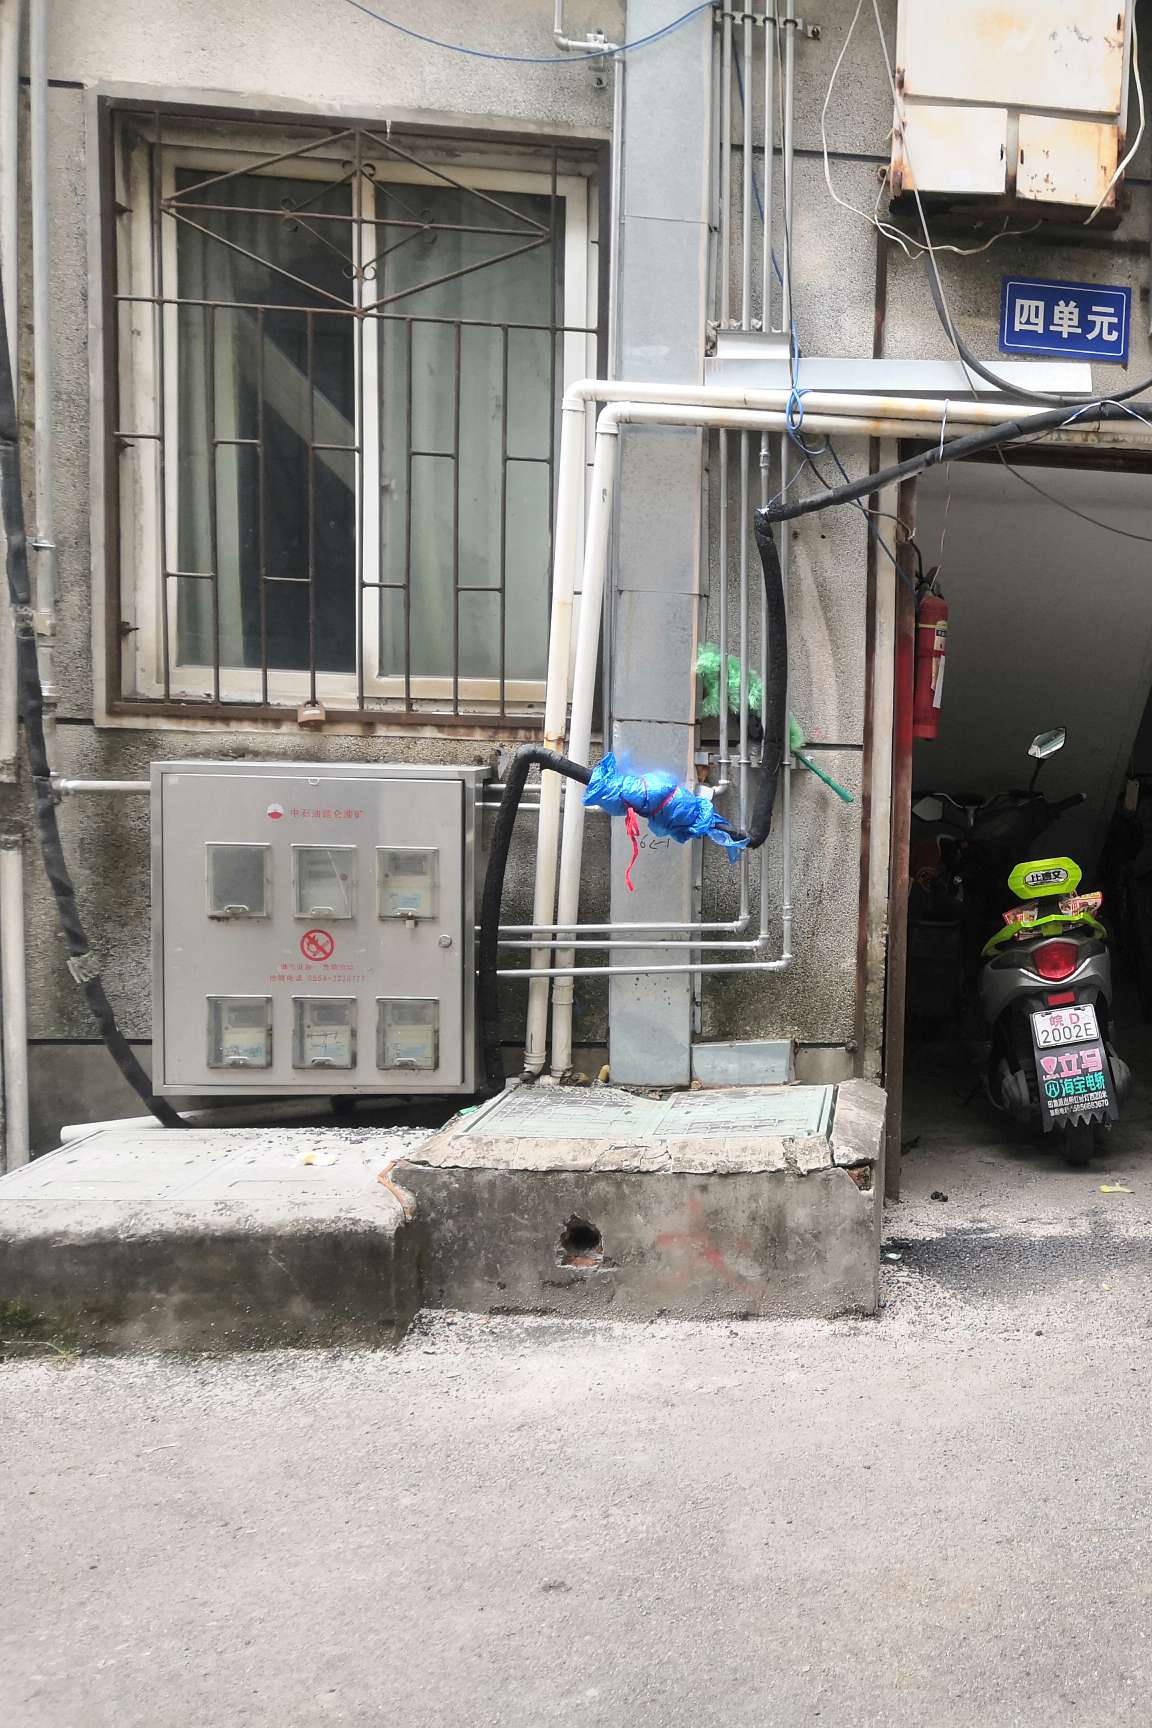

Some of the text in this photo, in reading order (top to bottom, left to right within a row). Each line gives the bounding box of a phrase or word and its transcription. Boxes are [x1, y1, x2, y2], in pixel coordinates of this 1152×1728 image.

[1013, 298, 1119, 342] 四单元
[1040, 1022, 1096, 1044] 2002E
[1058, 1048, 1103, 1077] 立马
